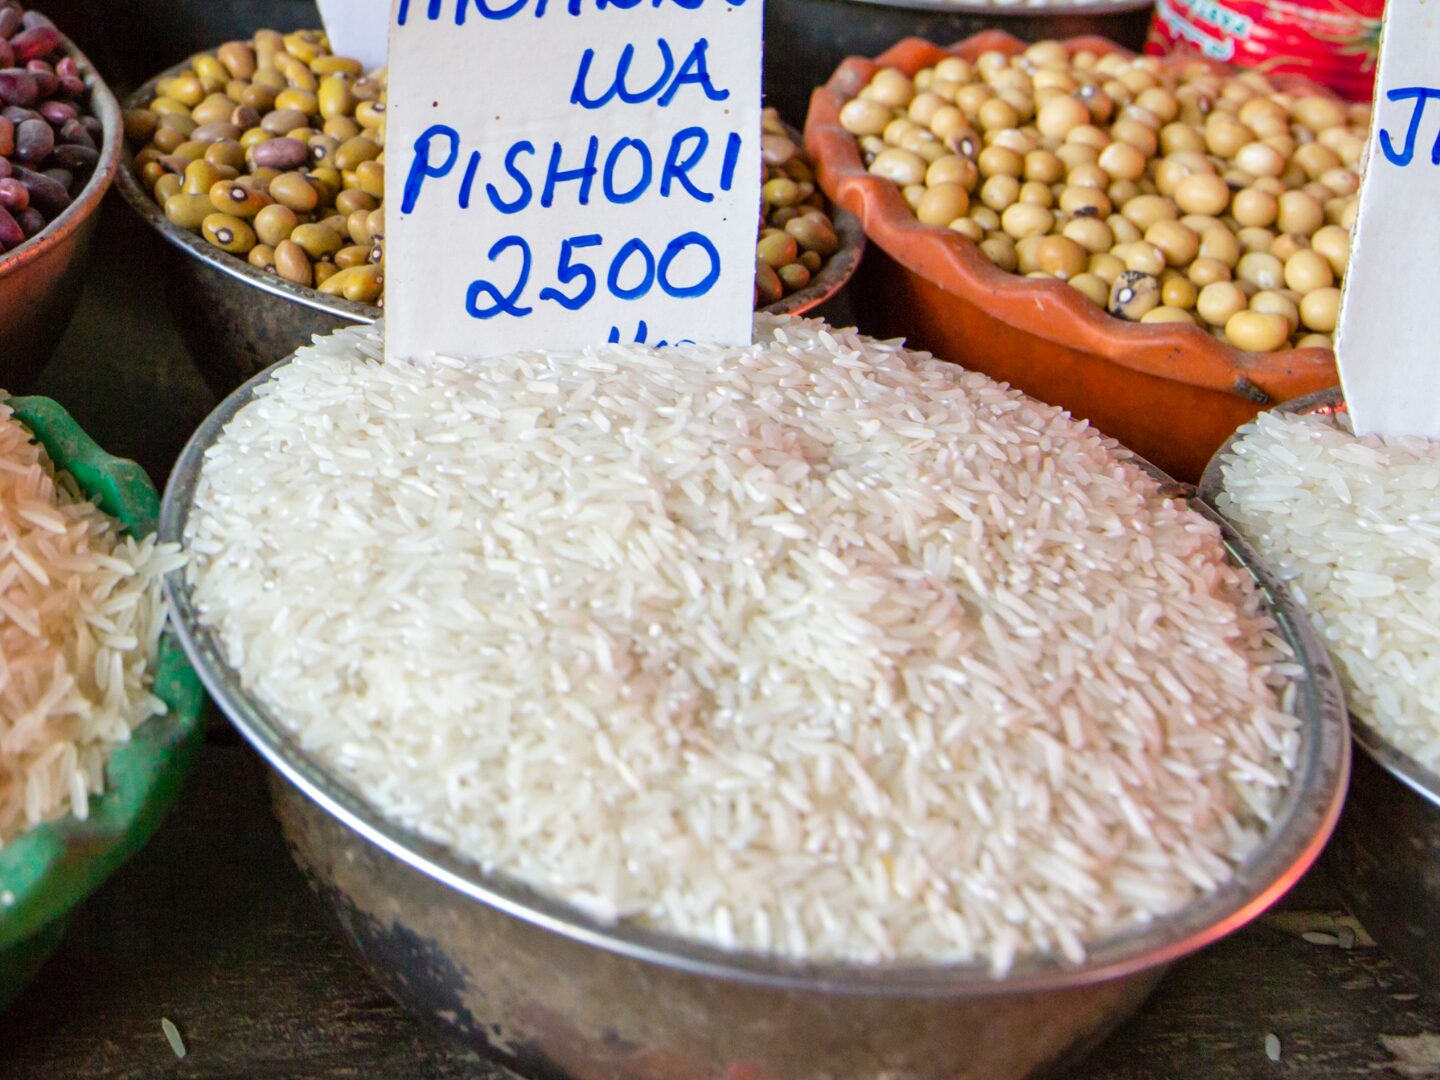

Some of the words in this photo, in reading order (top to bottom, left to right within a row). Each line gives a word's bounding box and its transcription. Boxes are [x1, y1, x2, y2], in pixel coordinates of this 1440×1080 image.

[570, 37, 731, 110] WA
[400, 123, 742, 215] PISHORI
[465, 230, 721, 320] 2500
